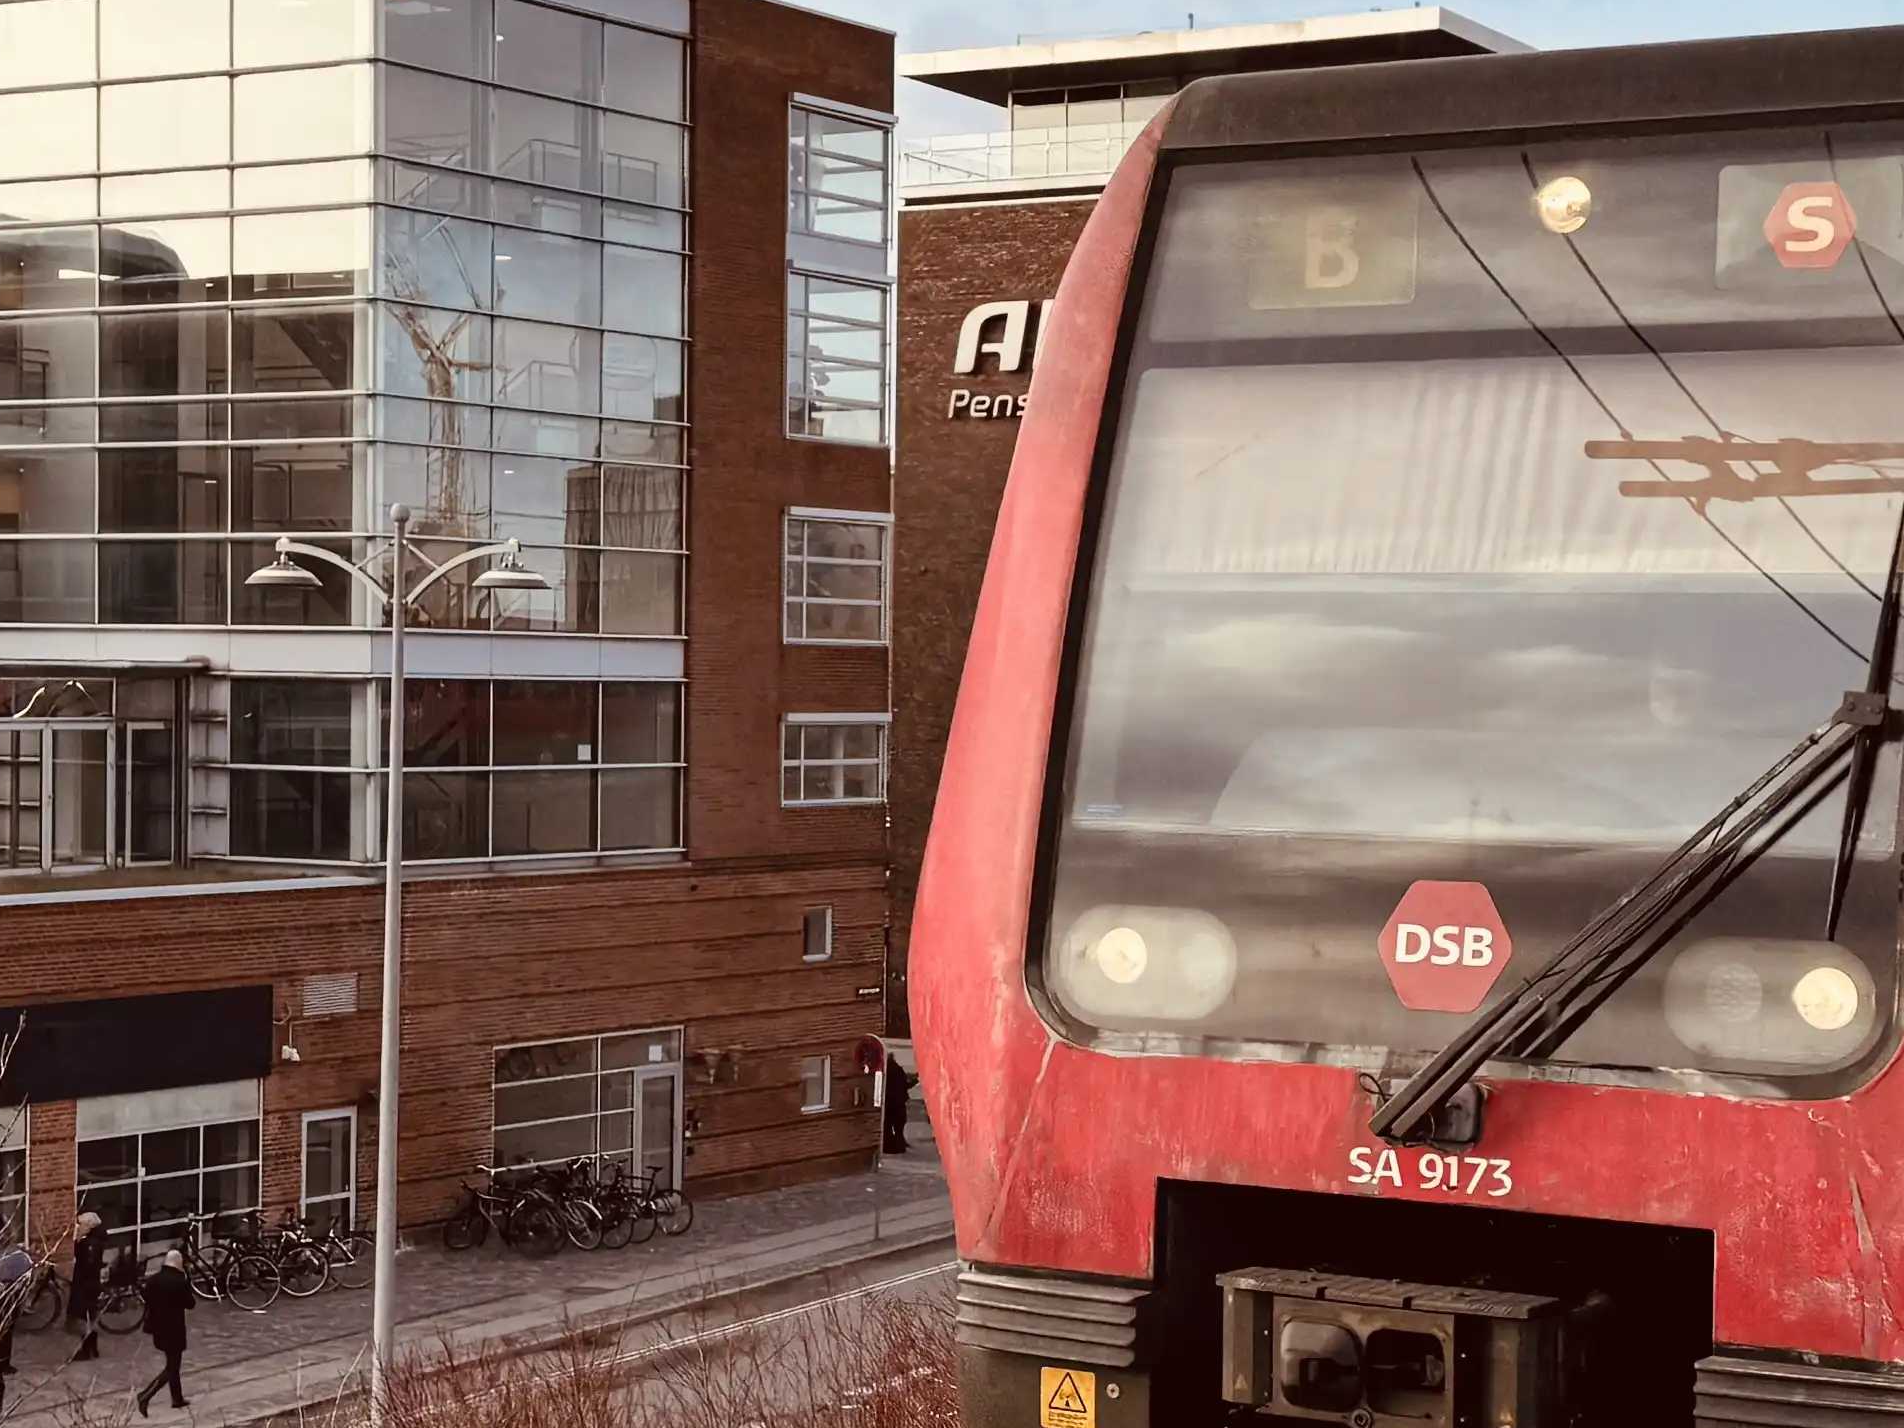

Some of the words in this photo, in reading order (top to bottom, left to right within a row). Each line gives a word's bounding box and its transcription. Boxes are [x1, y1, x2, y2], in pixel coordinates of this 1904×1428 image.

[1305, 209, 1359, 290] B
[1785, 196, 1835, 252] S
[1395, 923, 1493, 967] DSB
[1347, 1146, 1403, 1187] SA
[1418, 1152, 1513, 1197] 9173
